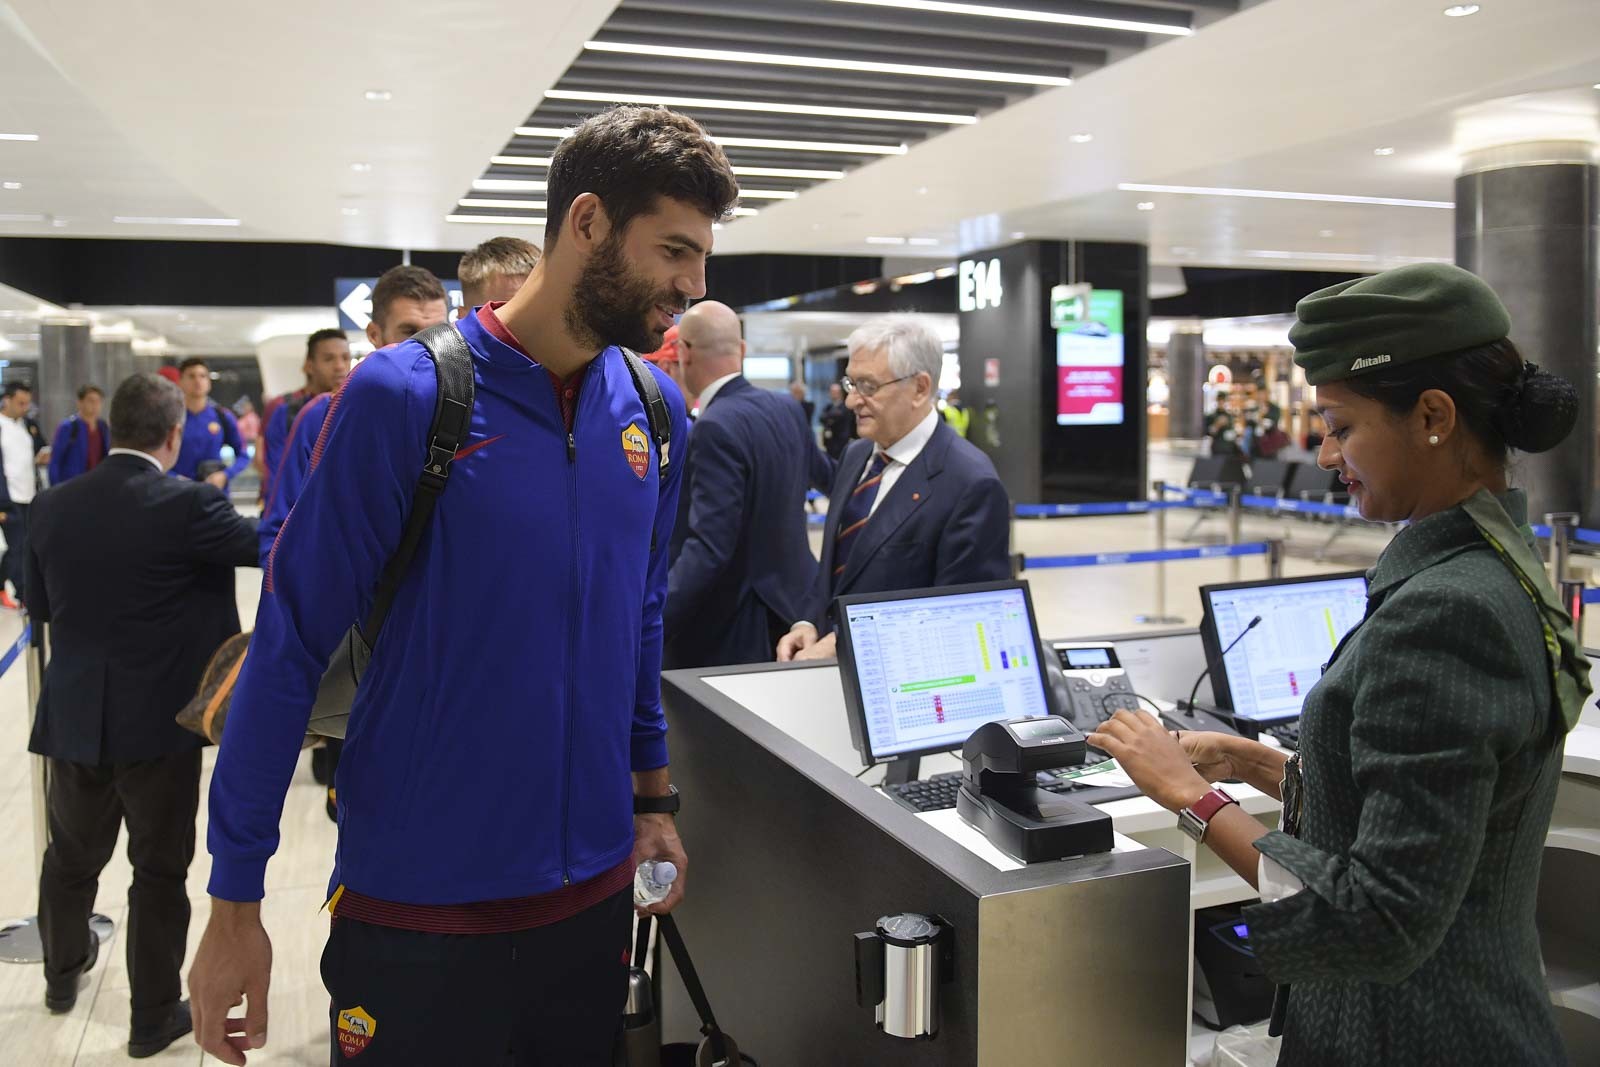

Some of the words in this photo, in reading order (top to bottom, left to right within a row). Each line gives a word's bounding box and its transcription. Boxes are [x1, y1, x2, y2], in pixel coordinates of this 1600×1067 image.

[958, 258, 1003, 312] E14
[1350, 354, 1392, 371] Alitalia
[627, 453, 648, 464] ROMA
[339, 1032, 365, 1047] ROMA
